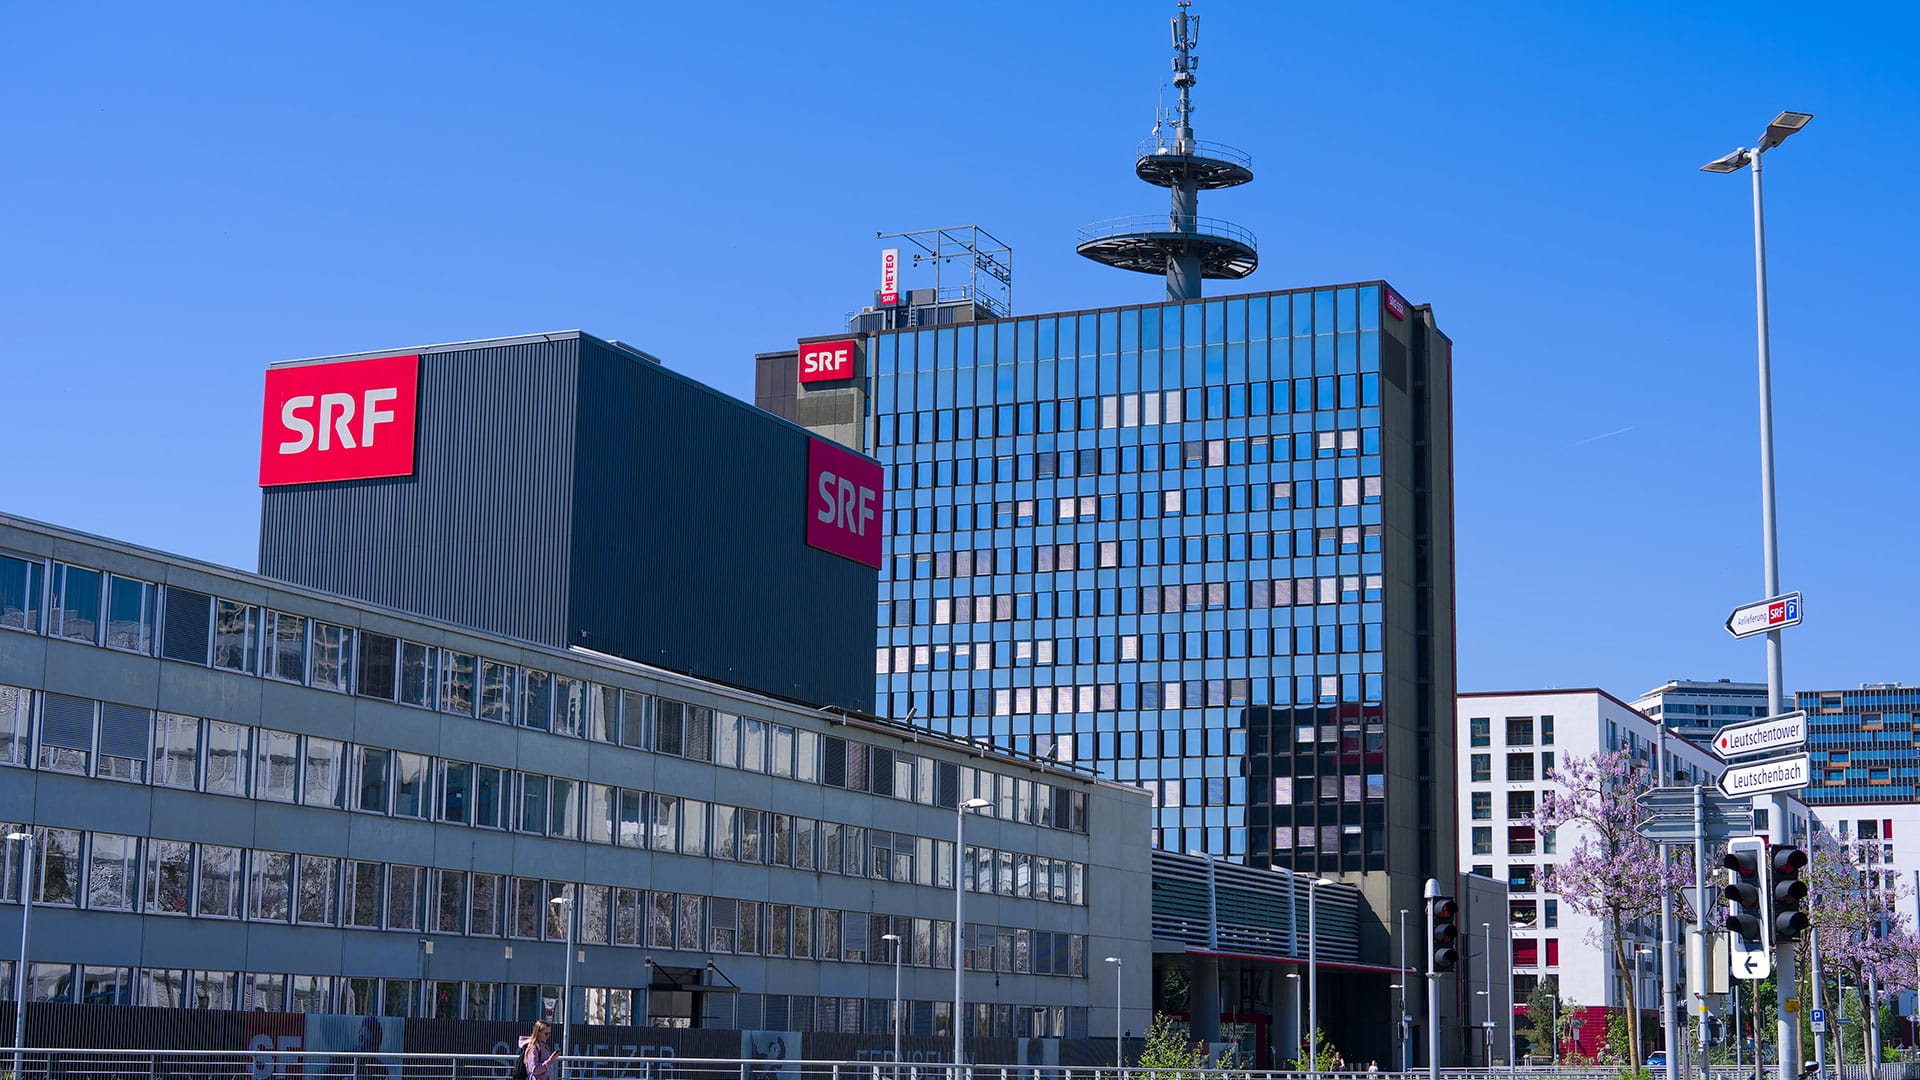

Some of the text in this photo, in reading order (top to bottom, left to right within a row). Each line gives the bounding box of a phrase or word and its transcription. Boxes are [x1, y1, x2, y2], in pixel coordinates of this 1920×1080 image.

[885, 254, 895, 291] METEO
[882, 295, 896, 303] SRF
[804, 349, 848, 373] SRF
[279, 387, 398, 454] SRF
[817, 470, 876, 537] SRF
[1737, 612, 1767, 625] Anlieferung
[1770, 606, 1784, 620] SRF
[1730, 724, 1800, 749] Leutschentower
[1733, 762, 1801, 789] Leutschenbach
